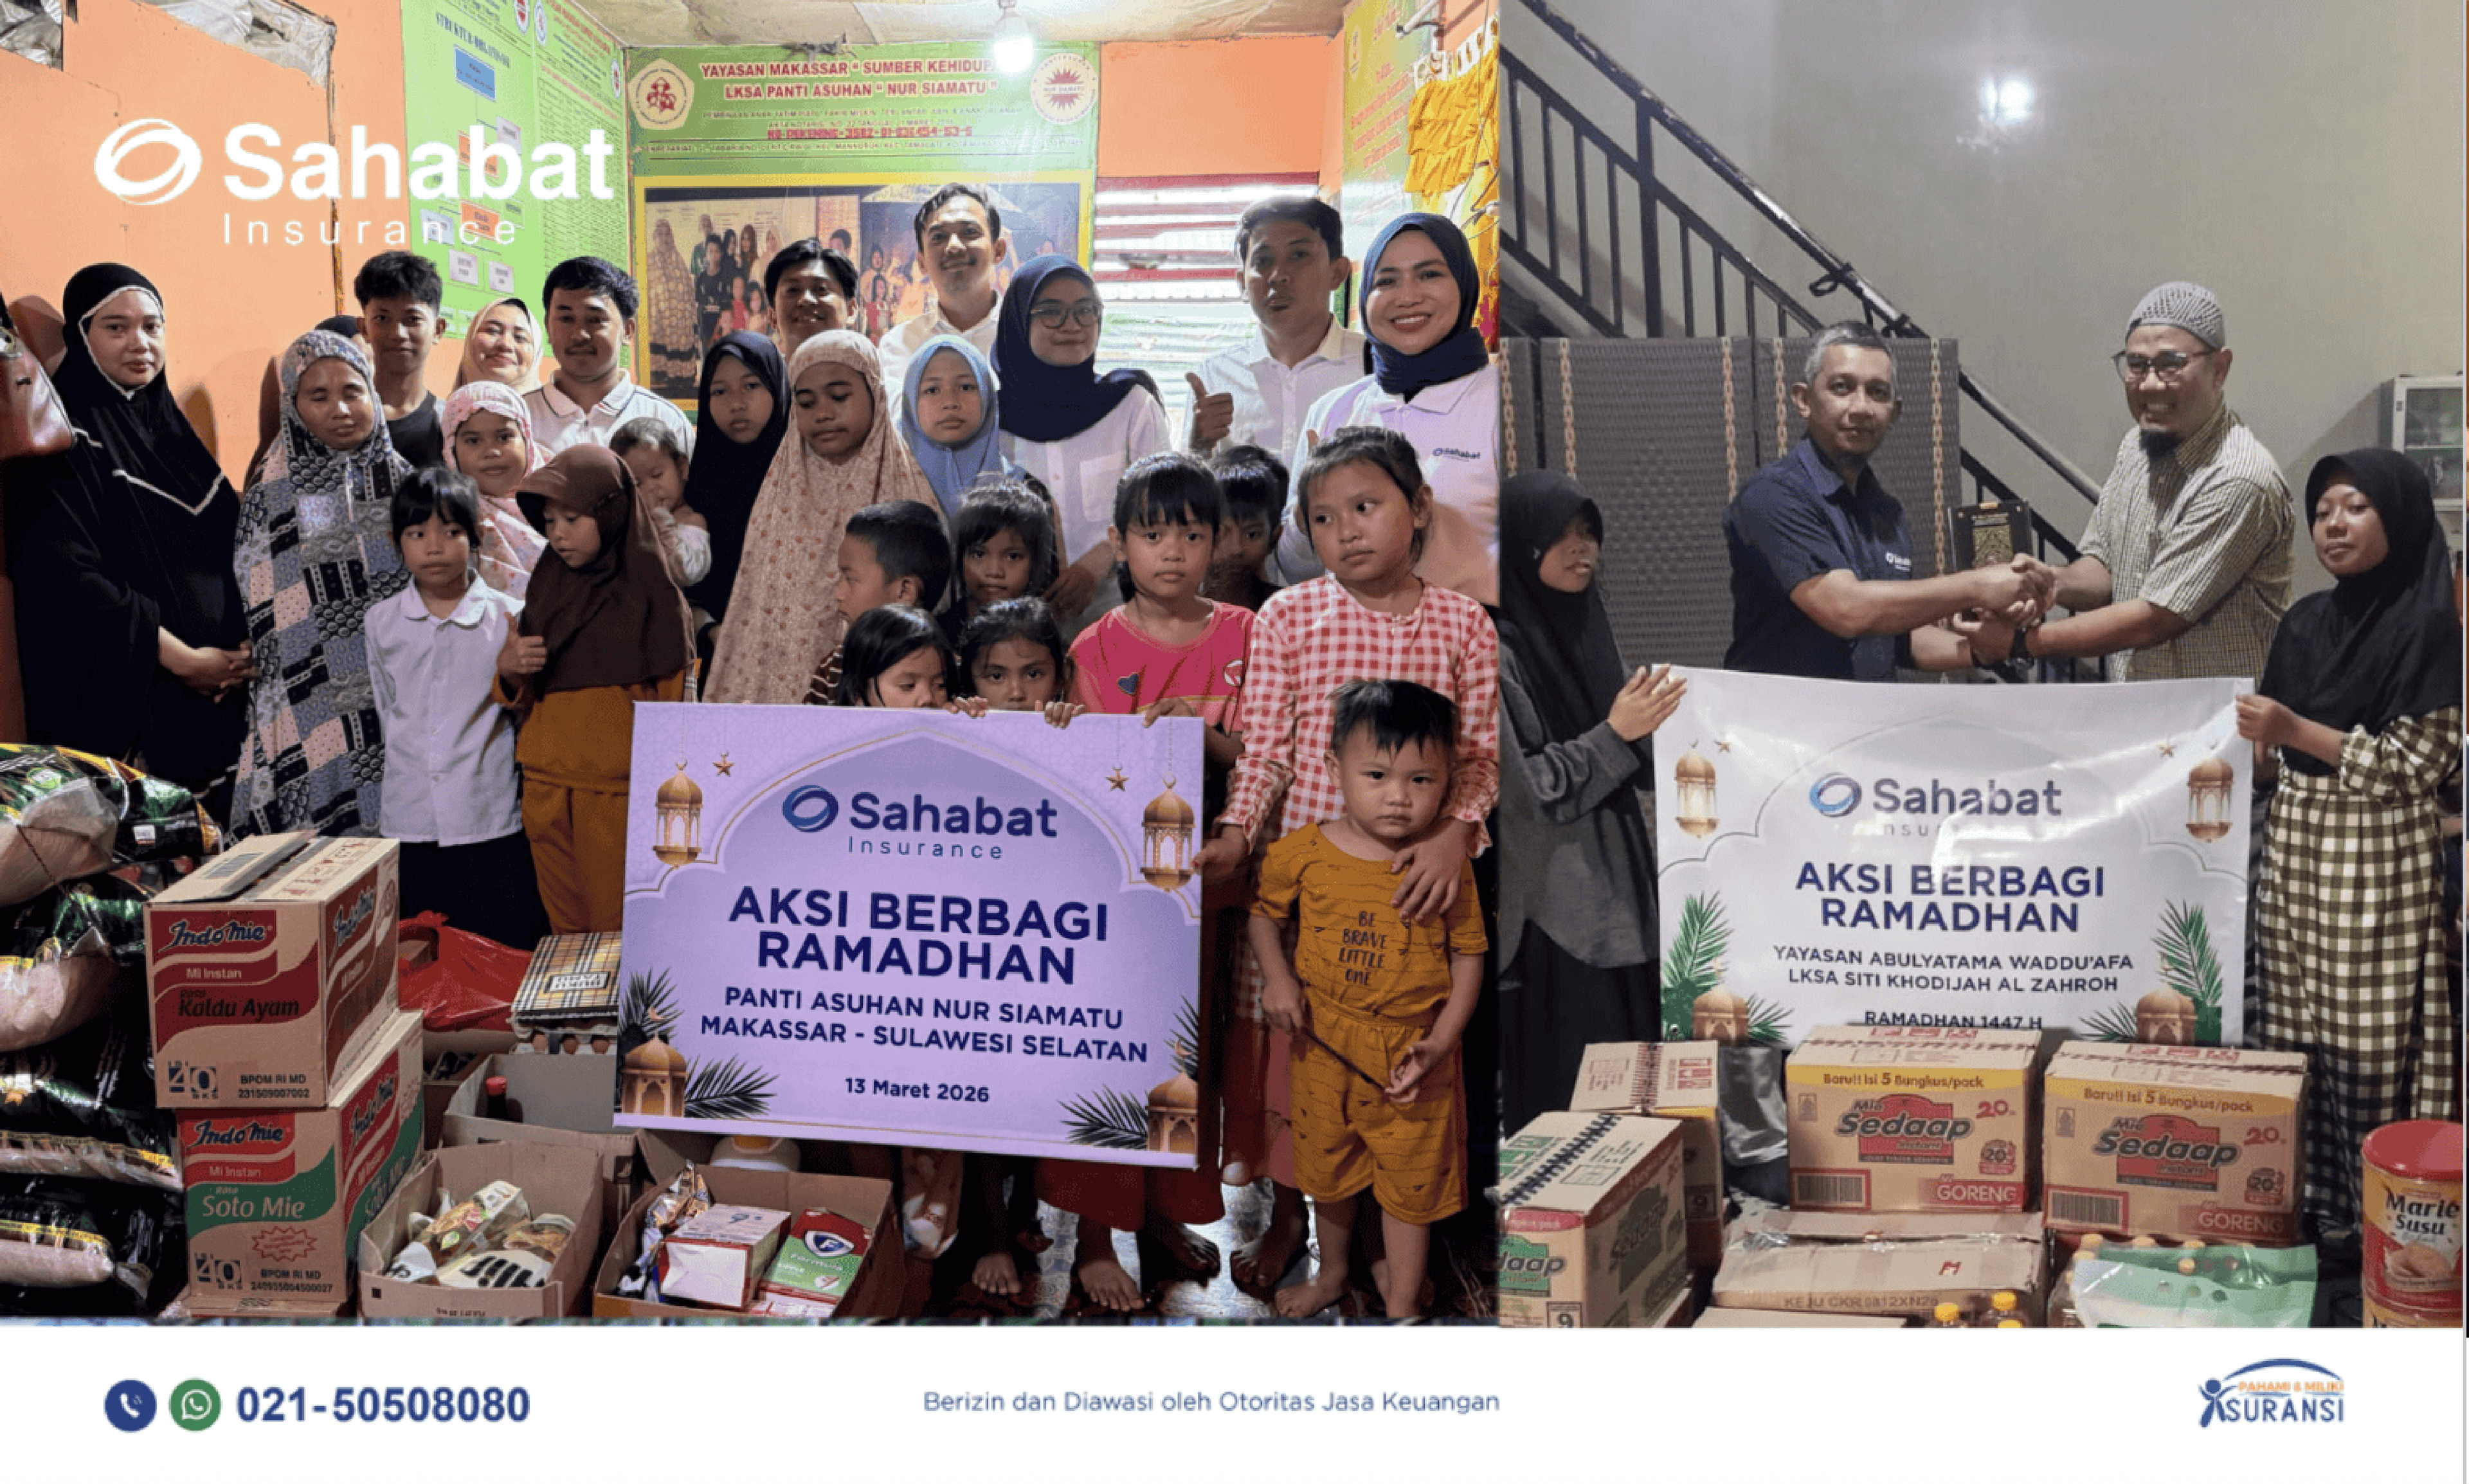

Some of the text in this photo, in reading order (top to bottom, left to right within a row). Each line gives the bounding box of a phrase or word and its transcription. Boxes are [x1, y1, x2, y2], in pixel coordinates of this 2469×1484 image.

[701, 64, 766, 78] YAYASAN
[769, 62, 849, 77] MAKASSAR
[863, 60, 924, 75] SUMBER
[928, 59, 995, 73] KEHIDUP
[726, 84, 763, 98] LKSA
[766, 84, 808, 98] PANTI
[813, 83, 873, 98] ASUHAN
[887, 82, 918, 96] NUR
[921, 80, 987, 95] SIAMATU
[1873, 778, 2062, 816] Sahabat
[849, 792, 1058, 838] Sahabat
[848, 836, 1003, 860] Insurance
[1796, 862, 2104, 898] AKSI BERBAGI
[728, 886, 1107, 941] AKSI BERBAGI
[1359, 910, 1375, 927] BE
[1821, 898, 2079, 933] RAMADHAN
[1343, 928, 1387, 949] BRAVE
[759, 932, 1075, 984] RAMADHAN
[1339, 948, 1384, 968] LITTLE
[1773, 946, 2133, 971] YAYASAN ABULYATAMA WADDU'AFA
[186, 968, 242, 979] Mi Instan
[1789, 968, 2118, 992] LKSA SITI KHODIJAH AL ZAHROH
[179, 998, 300, 1023] Kaldu Ayam
[725, 986, 1123, 1029] PANTI ASUHAN NUR SIAMATU
[1865, 1011, 2042, 1029] RAMADHAN 1447 H
[701, 1015, 846, 1043] MAKASSAR
[873, 1025, 1013, 1053] SULAWESI
[1023, 1035, 1147, 1063] SELATAN
[240, 1074, 306, 1084] BPOM RI MD
[846, 1078, 990, 1103] 13 Maret 2026
[1865, 1074, 1878, 1085] Isi
[1881, 1072, 1892, 1085] 5
[1894, 1075, 1985, 1089] Bungkus/pack
[2127, 1091, 2140, 1103] Isi
[2144, 1090, 2155, 1104] 5
[2158, 1093, 2254, 1113] Bungkus/pack
[1835, 1112, 1973, 1141] Sedaap
[2094, 1132, 2240, 1168] Sedaap
[225, 1167, 260, 1177] Instan
[1937, 1184, 2017, 1202] GORENG
[2383, 1188, 2461, 1218] Marie
[203, 1195, 305, 1219] Soto Mie
[2199, 1212, 2284, 1233] GORENG
[2395, 1214, 2445, 1235] Susu
[260, 1269, 289, 1279] BPOM
[304, 1270, 321, 1280] MD
